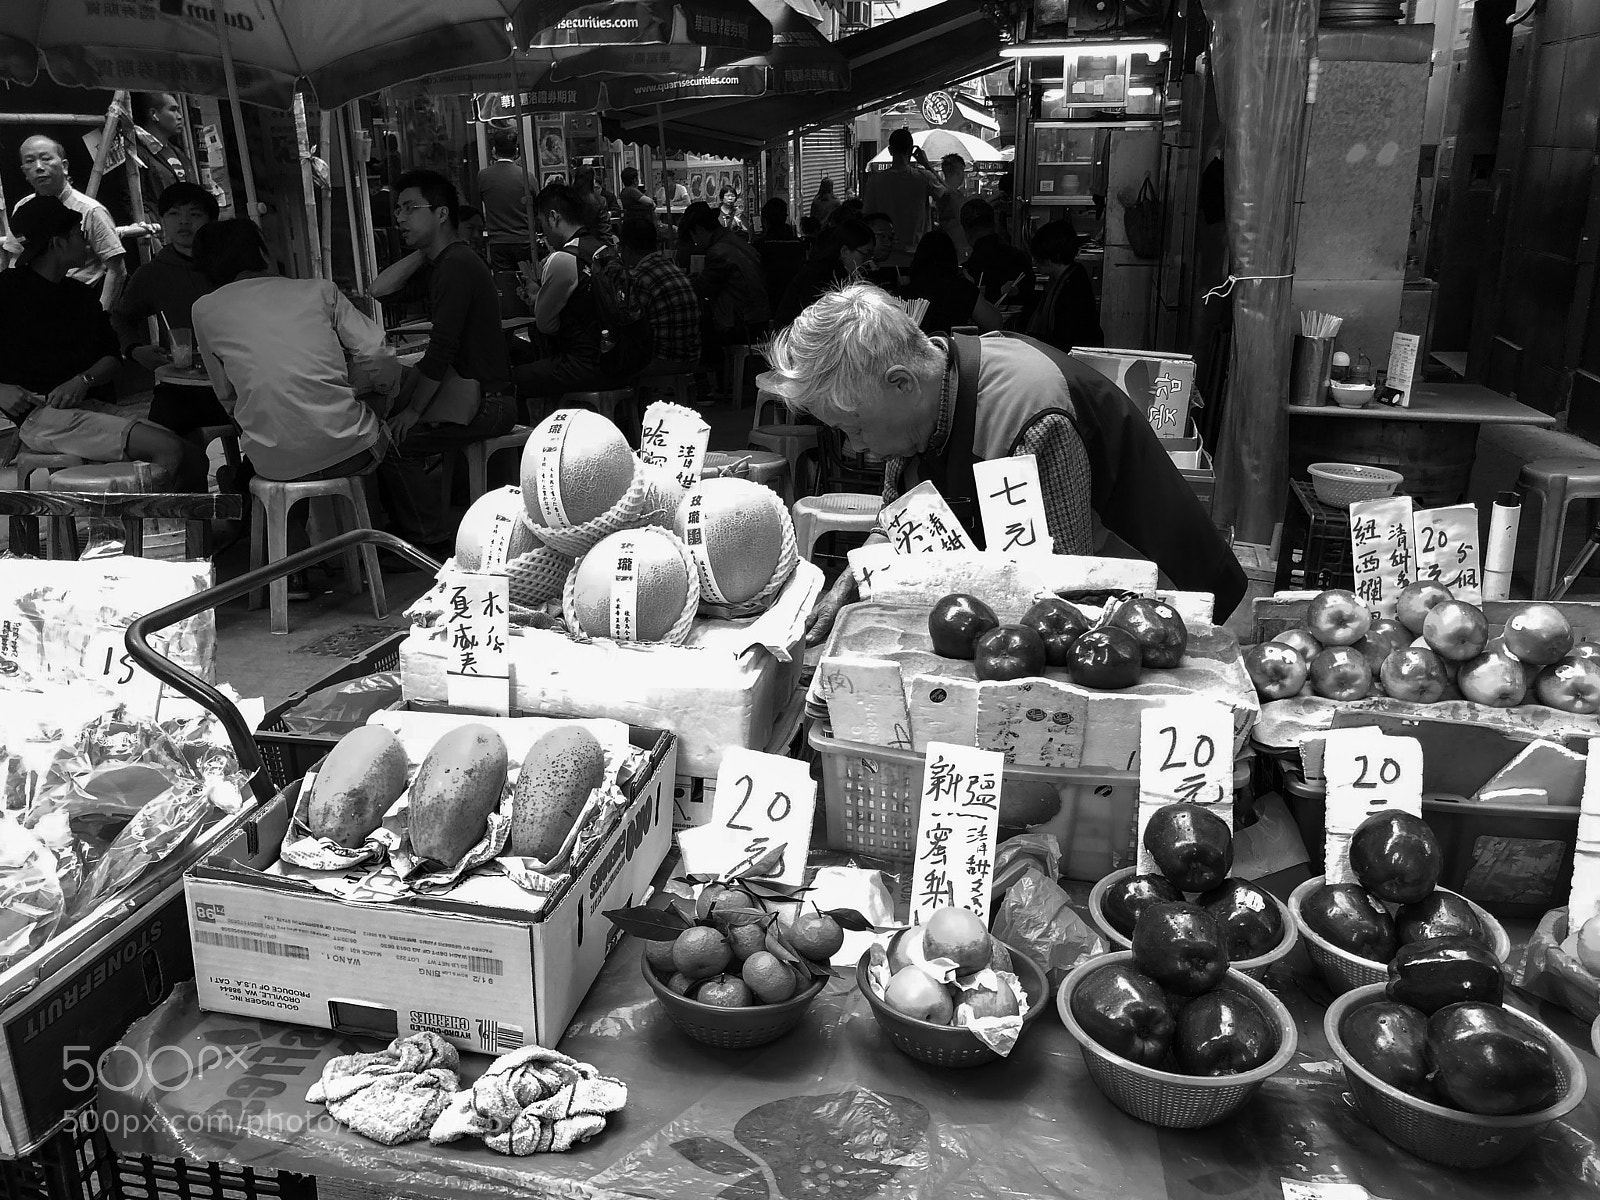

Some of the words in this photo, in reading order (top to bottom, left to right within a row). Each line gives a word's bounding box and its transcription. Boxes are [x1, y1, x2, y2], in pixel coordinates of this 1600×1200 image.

[633, 75, 739, 95] www.quamsecurities.com
[1421, 526, 1448, 554] 20
[1159, 726, 1215, 772] 20
[1352, 755, 1401, 789] 20
[726, 775, 791, 831] 20
[196, 906, 215, 920] 98
[332, 954, 346, 963] NO
[347, 957, 361, 966] WA
[418, 968, 441, 977] BING
[23, 920, 163, 1043] STONEFRUIT
[259, 991, 300, 1003] OROVILLE,
[272, 986, 310, 998] PRODUCE
[245, 997, 275, 1007] DIGGER
[277, 1002, 299, 1011] GOLD
[409, 1010, 469, 1031] CHERRIES
